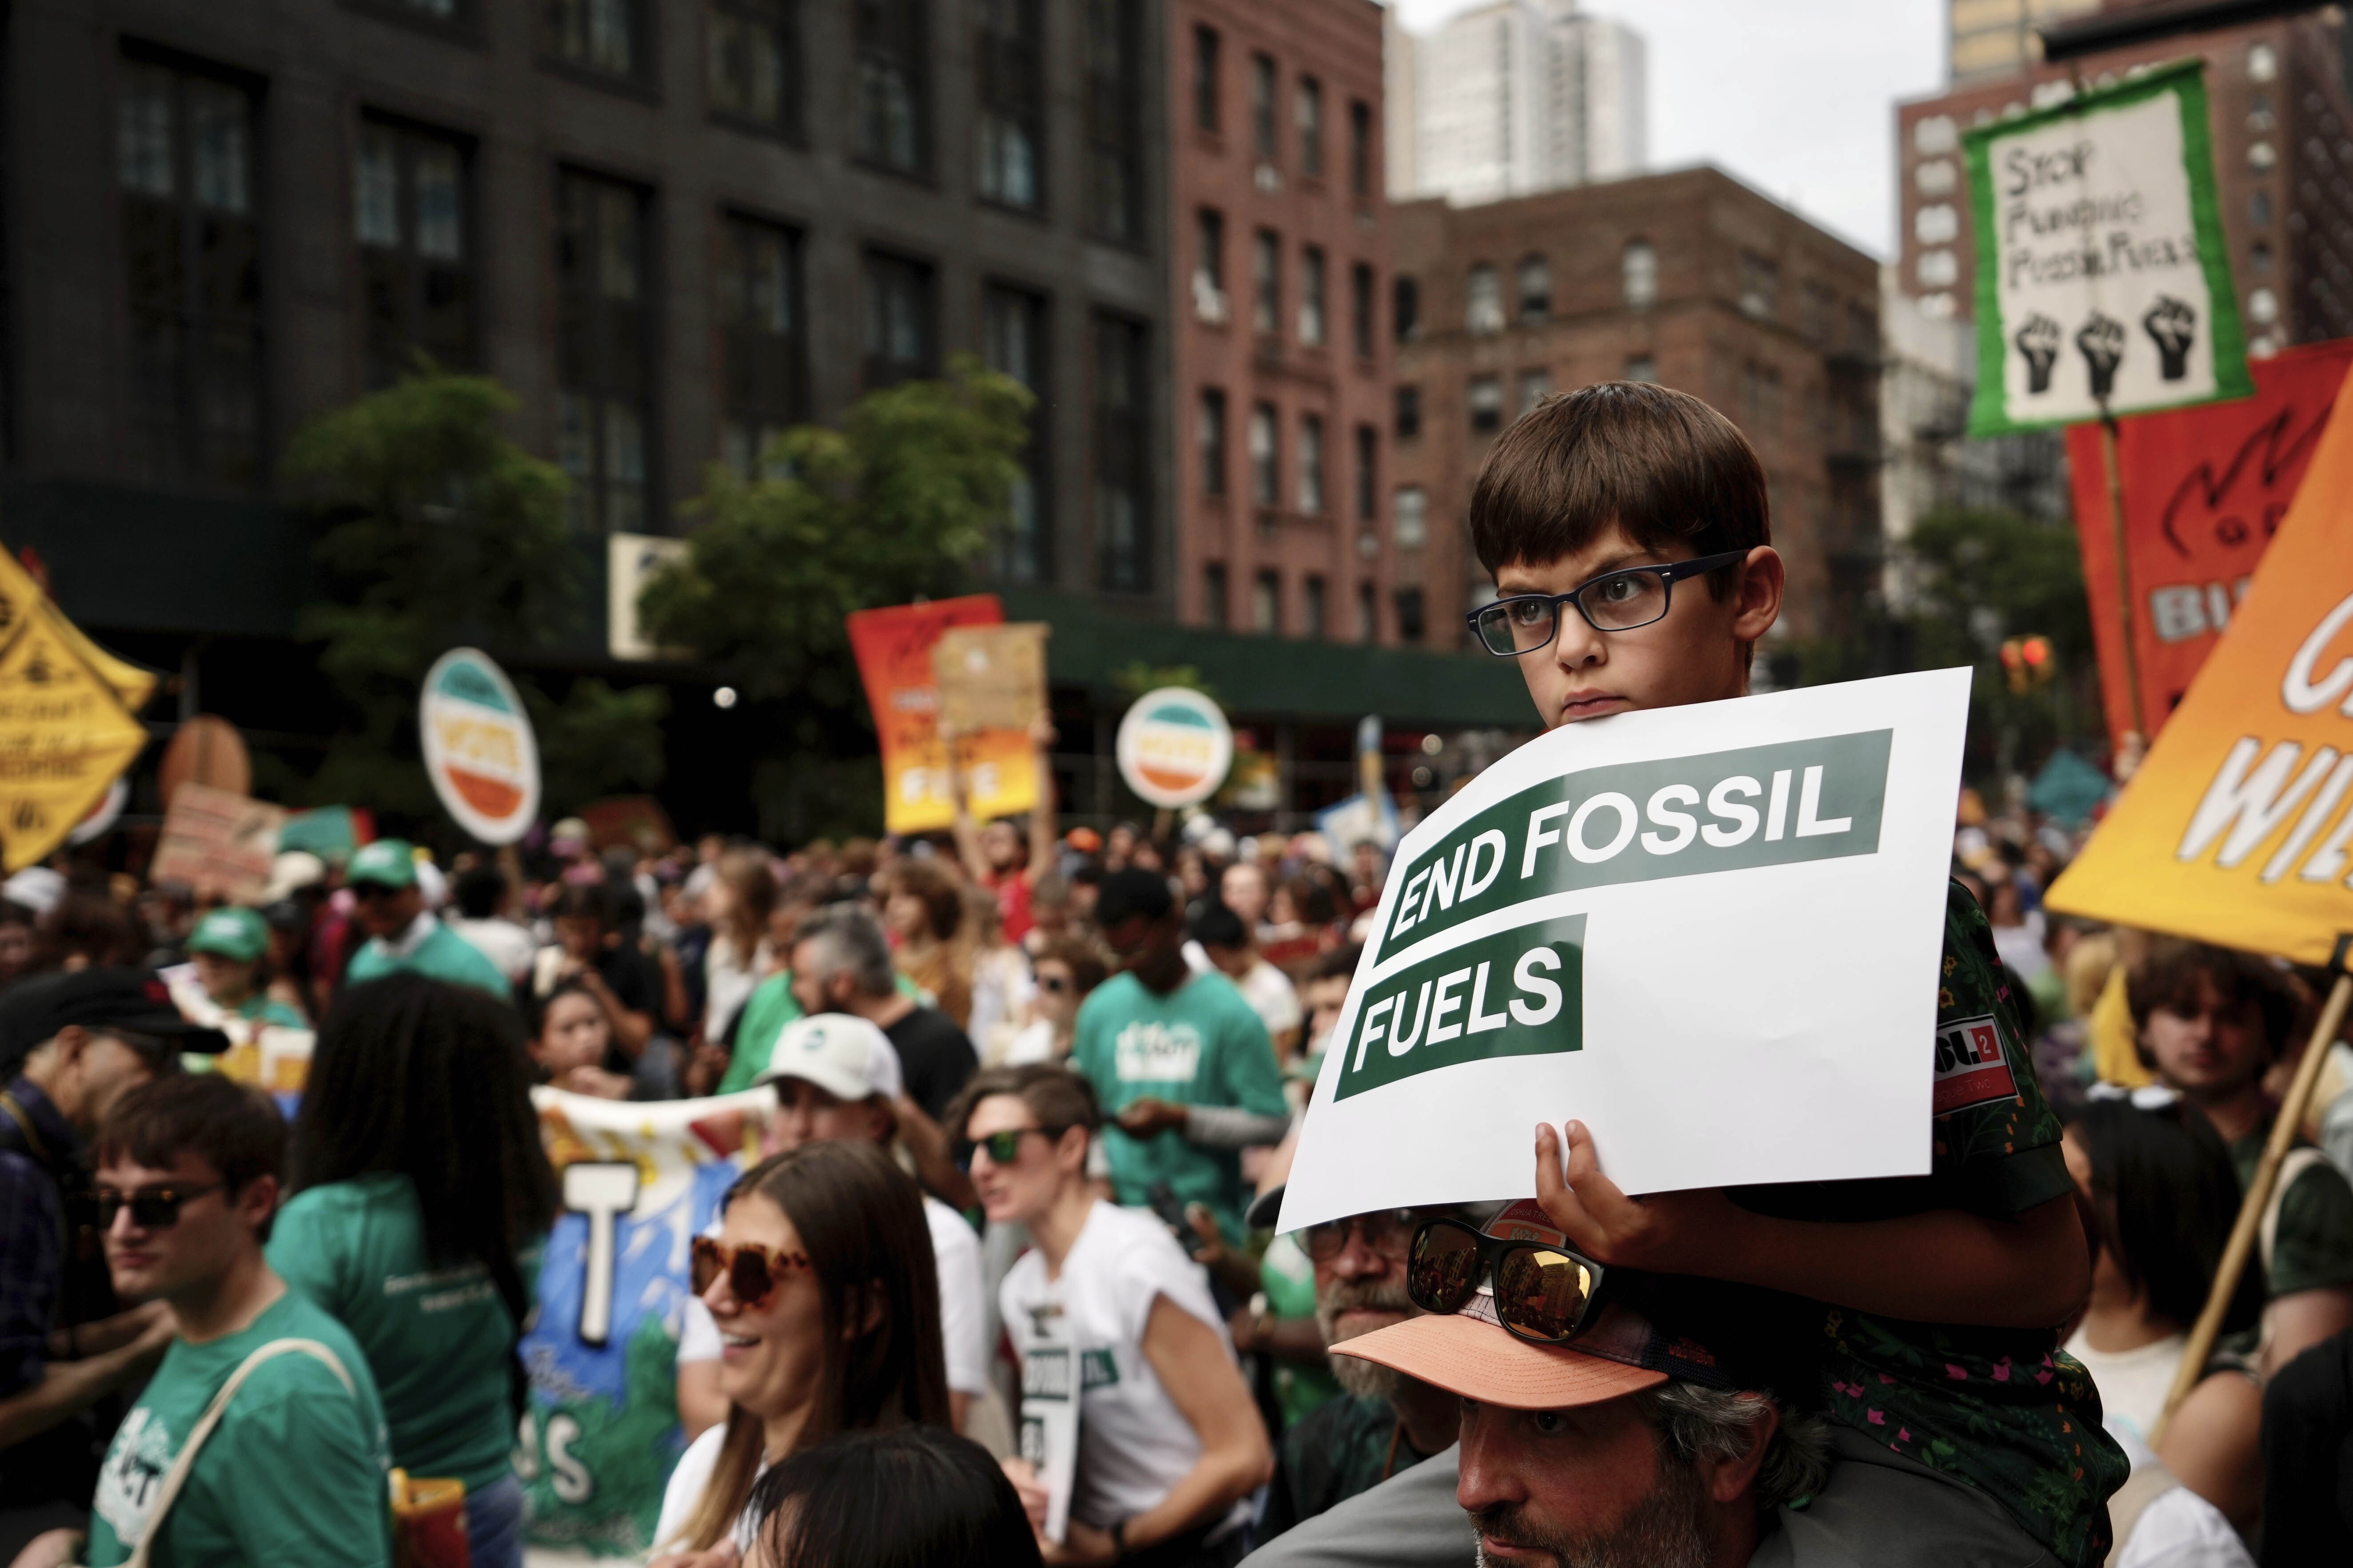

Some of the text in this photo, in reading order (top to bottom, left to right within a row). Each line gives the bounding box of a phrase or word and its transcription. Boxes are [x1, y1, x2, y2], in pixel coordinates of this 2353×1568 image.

[2150, 573, 2253, 643] BI
[1390, 765, 1852, 941] END FOSSIL
[2174, 734, 2353, 894] WIL
[1352, 947, 1563, 1073] FUELS
[1979, 1035, 1991, 1054] 2
[1965, 1078, 1991, 1092] Two
